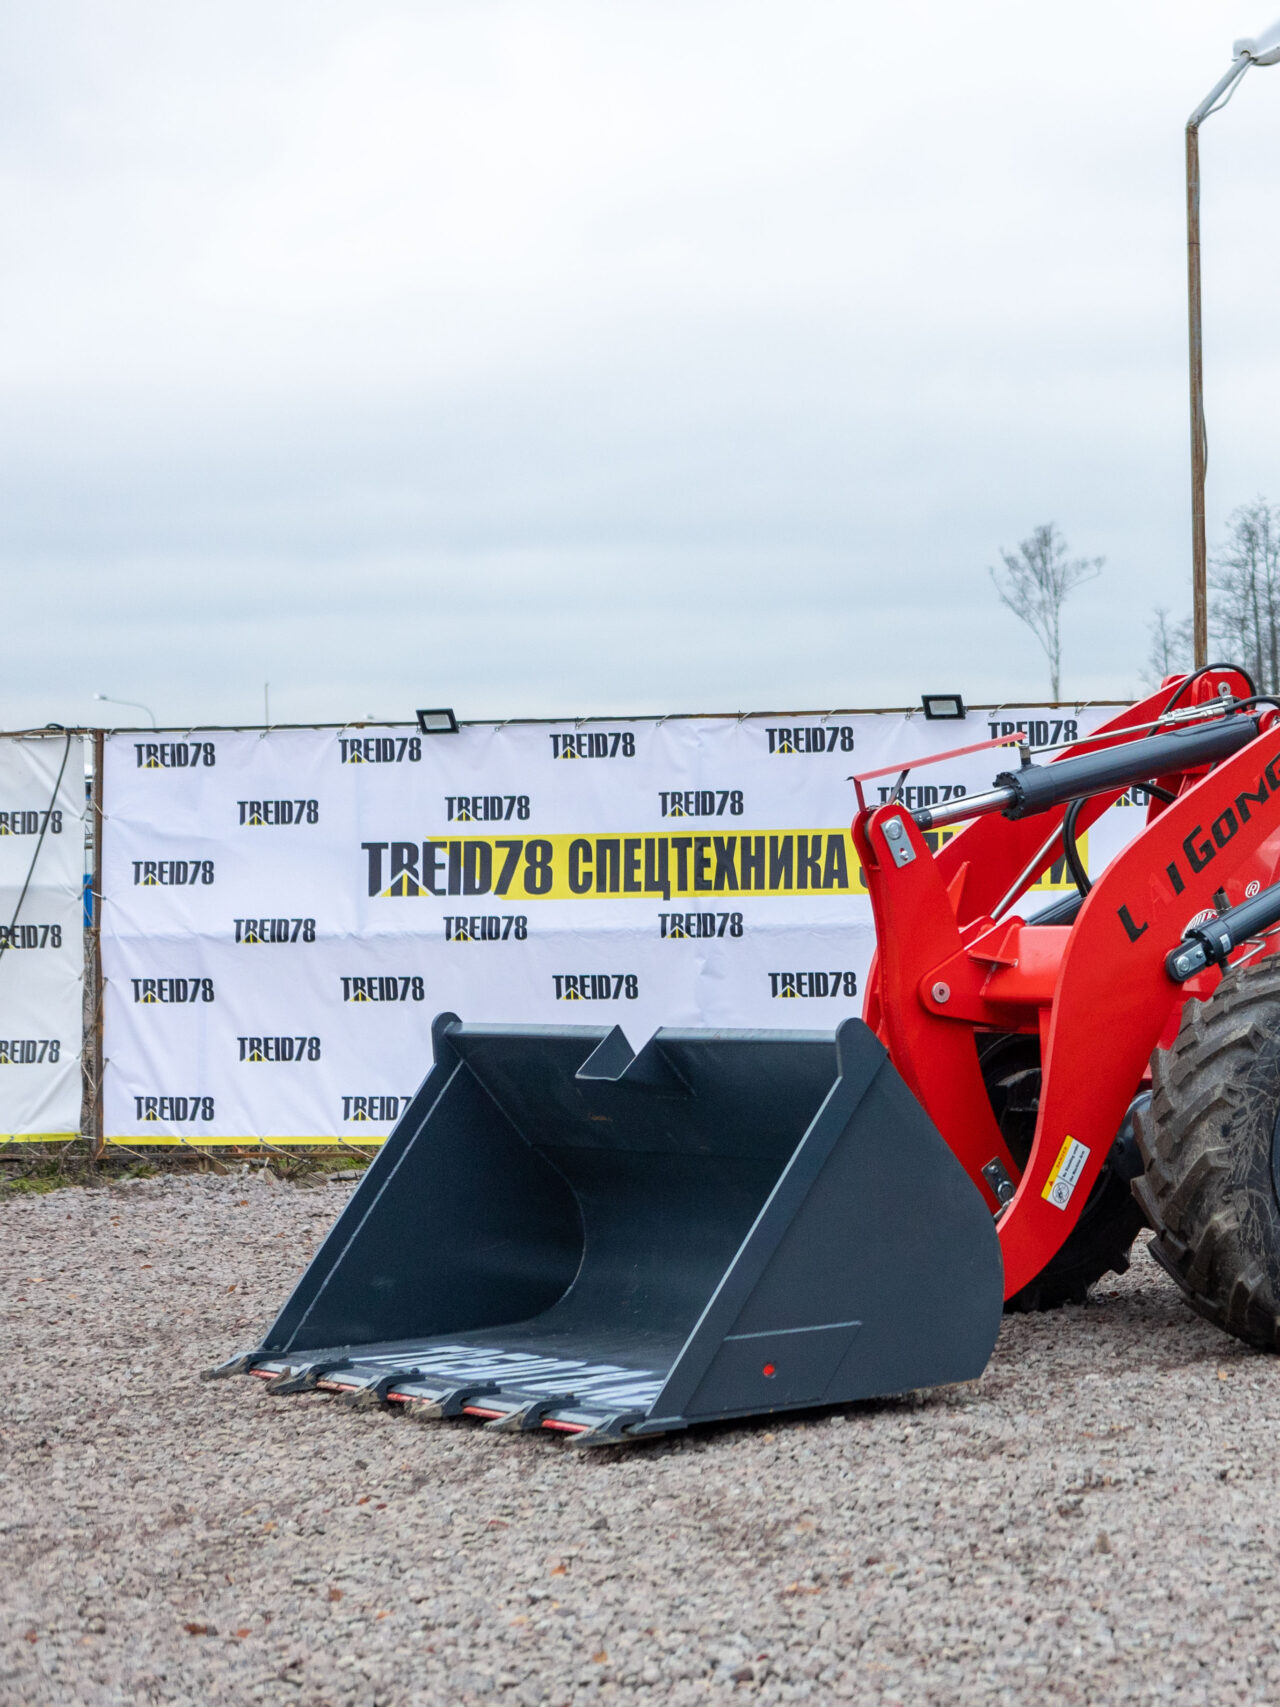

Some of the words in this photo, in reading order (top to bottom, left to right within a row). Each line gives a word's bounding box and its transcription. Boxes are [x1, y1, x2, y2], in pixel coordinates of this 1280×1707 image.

[549, 732, 636, 759] TREID78
[765, 727, 854, 753] TREID78
[987, 720, 1079, 748] TREID78
[133, 743, 215, 768] TREID78
[338, 737, 422, 763] TREID78
[237, 800, 319, 825] TREID78
[444, 796, 530, 822] TREID78
[658, 791, 744, 817] TREID78
[132, 861, 215, 886] TREID78
[361, 839, 553, 896] TREID78
[569, 834, 849, 901] СПЕЦТЕХНИКА
[233, 919, 316, 943] TREID78
[443, 916, 528, 941] TREID78
[658, 912, 744, 938] TREID78
[131, 978, 215, 1003] TREID78
[340, 976, 425, 1002] TREID78
[552, 975, 638, 1000] TREID78
[768, 972, 857, 998] TREID78
[237, 1037, 320, 1062] TREID78
[133, 1096, 215, 1121] TREID78
[341, 1096, 413, 1121] TREID7
